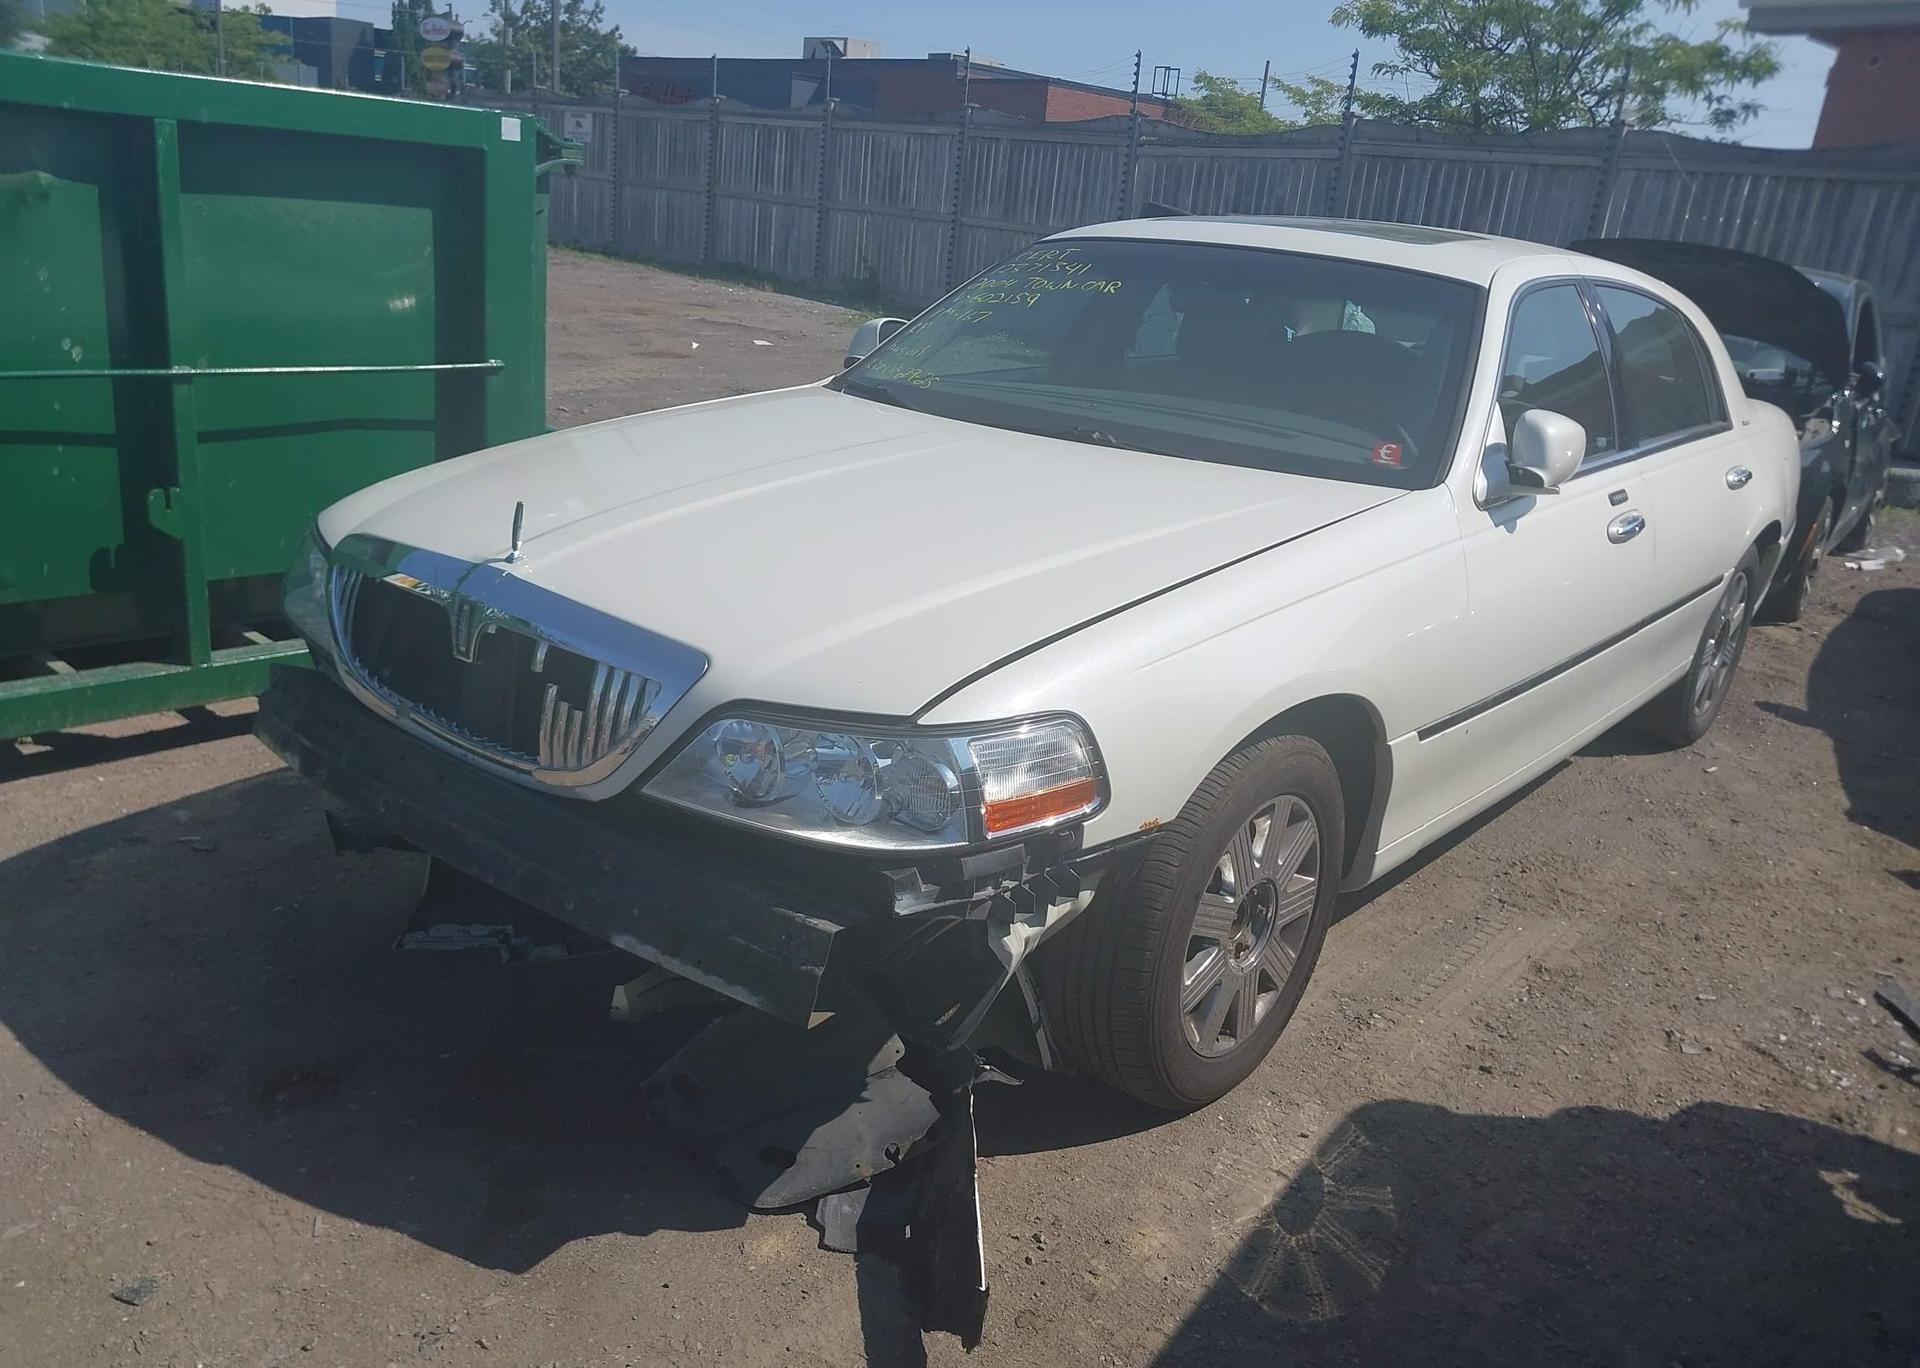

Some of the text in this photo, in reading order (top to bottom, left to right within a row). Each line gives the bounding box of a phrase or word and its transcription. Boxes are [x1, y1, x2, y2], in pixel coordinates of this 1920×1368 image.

[967, 276, 1122, 294] 2004 TOWN CAR
